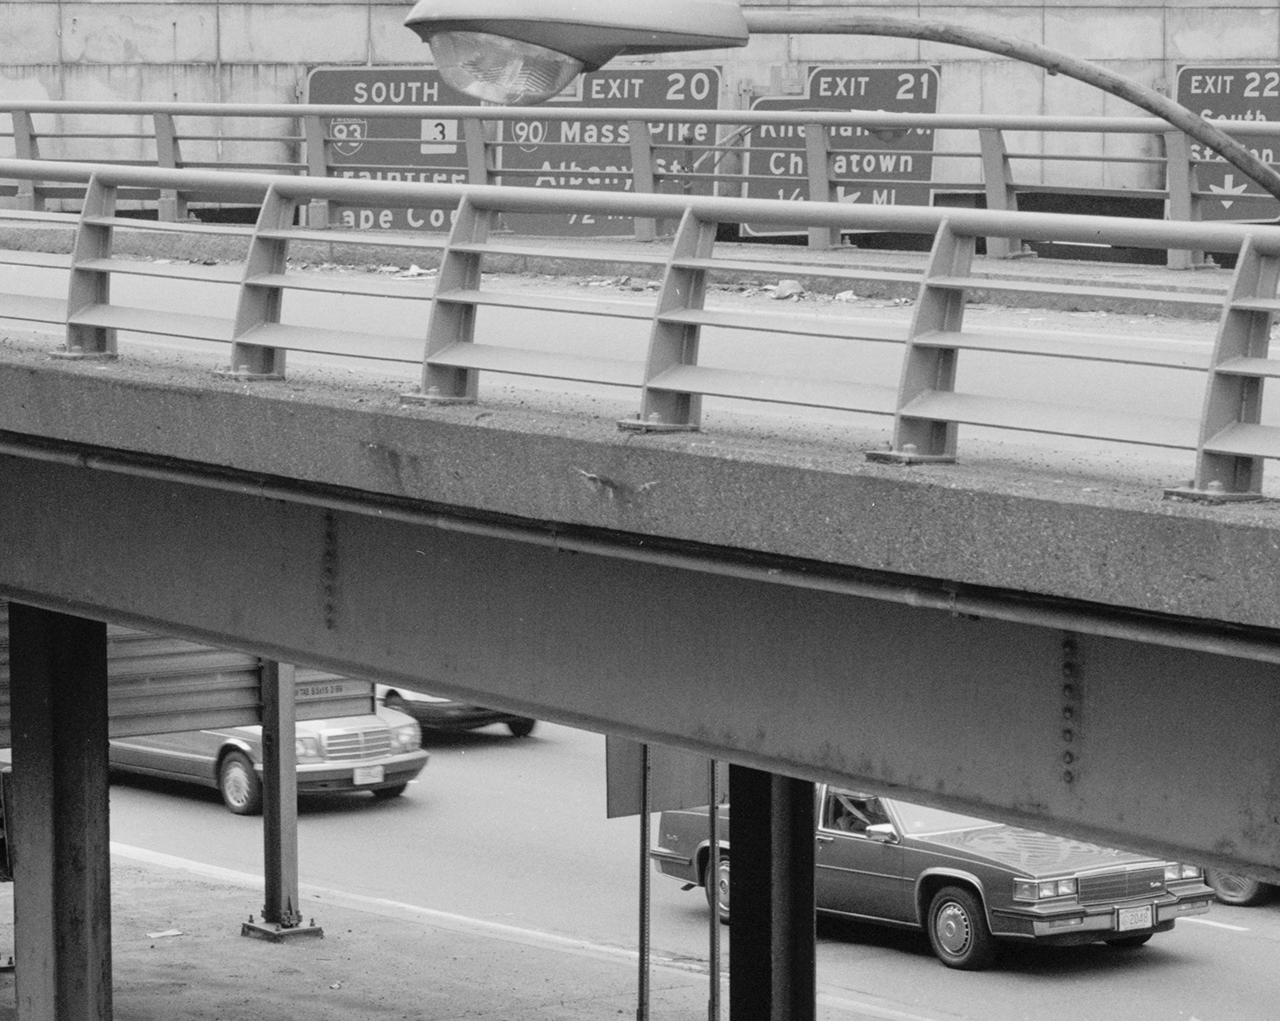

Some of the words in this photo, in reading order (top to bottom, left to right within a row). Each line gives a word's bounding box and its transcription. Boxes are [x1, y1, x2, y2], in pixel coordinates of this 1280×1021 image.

[354, 82, 438, 103] SOUTH
[592, 79, 644, 99] EXIT
[666, 73, 711, 101] 20
[820, 77, 869, 96] EXIT
[895, 73, 929, 100] 21
[1191, 76, 1234, 94] EXIT
[1243, 72, 1280, 97] 22
[334, 124, 361, 146] 93
[433, 122, 446, 141] 3
[515, 121, 543, 143] 90
[560, 121, 631, 143] Mass
[769, 151, 913, 175] Chatown
[536, 161, 634, 190] Albany
